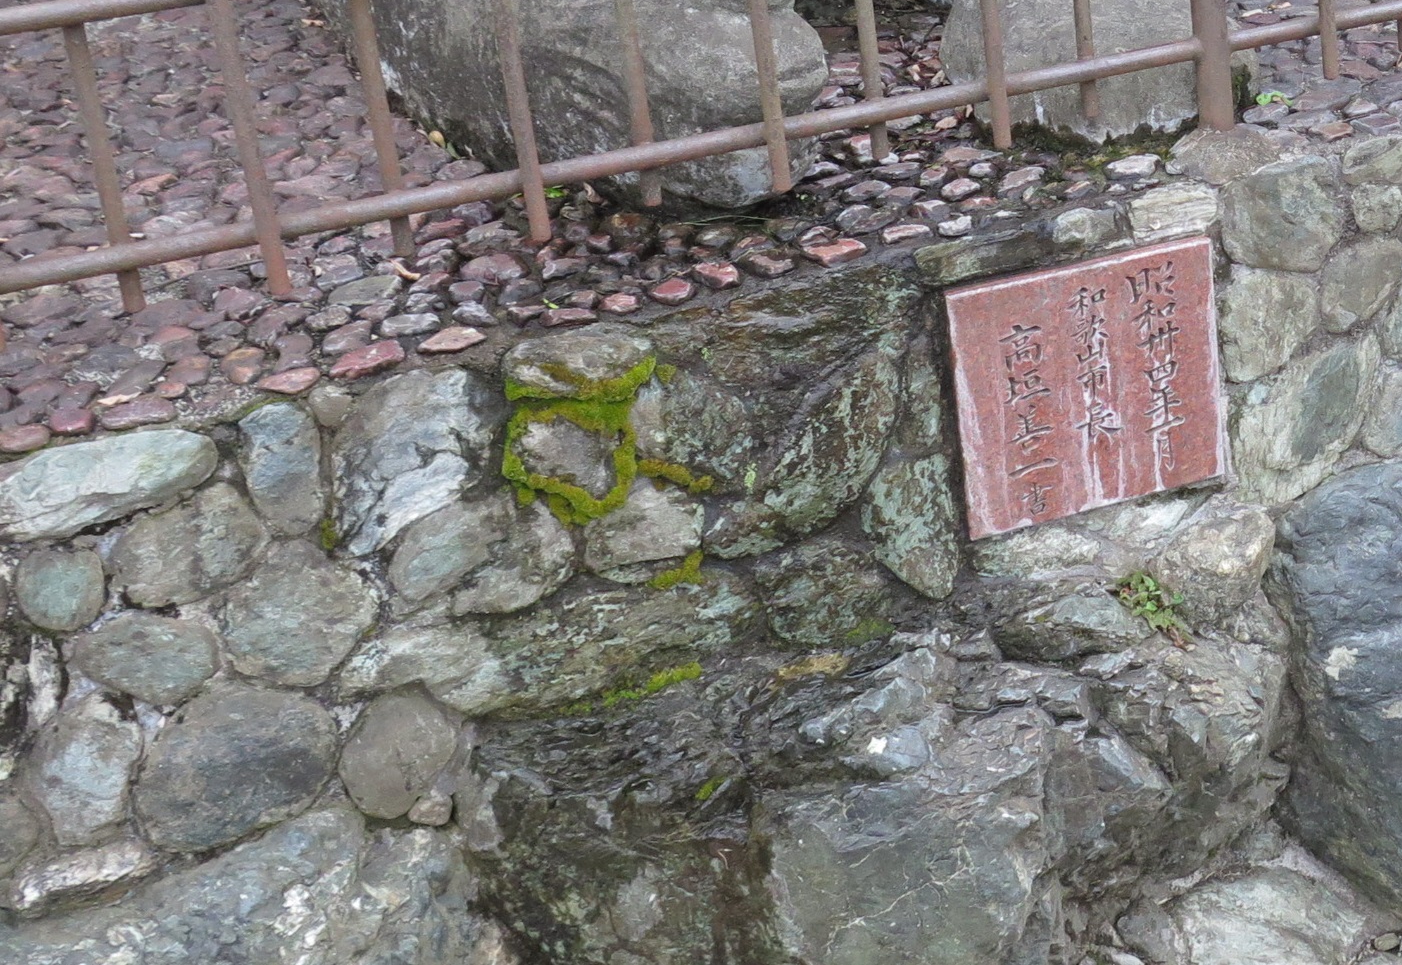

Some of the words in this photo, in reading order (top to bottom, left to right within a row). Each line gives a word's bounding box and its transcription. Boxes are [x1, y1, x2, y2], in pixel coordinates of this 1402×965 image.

[1067, 287, 1122, 446] 和歌山市長
